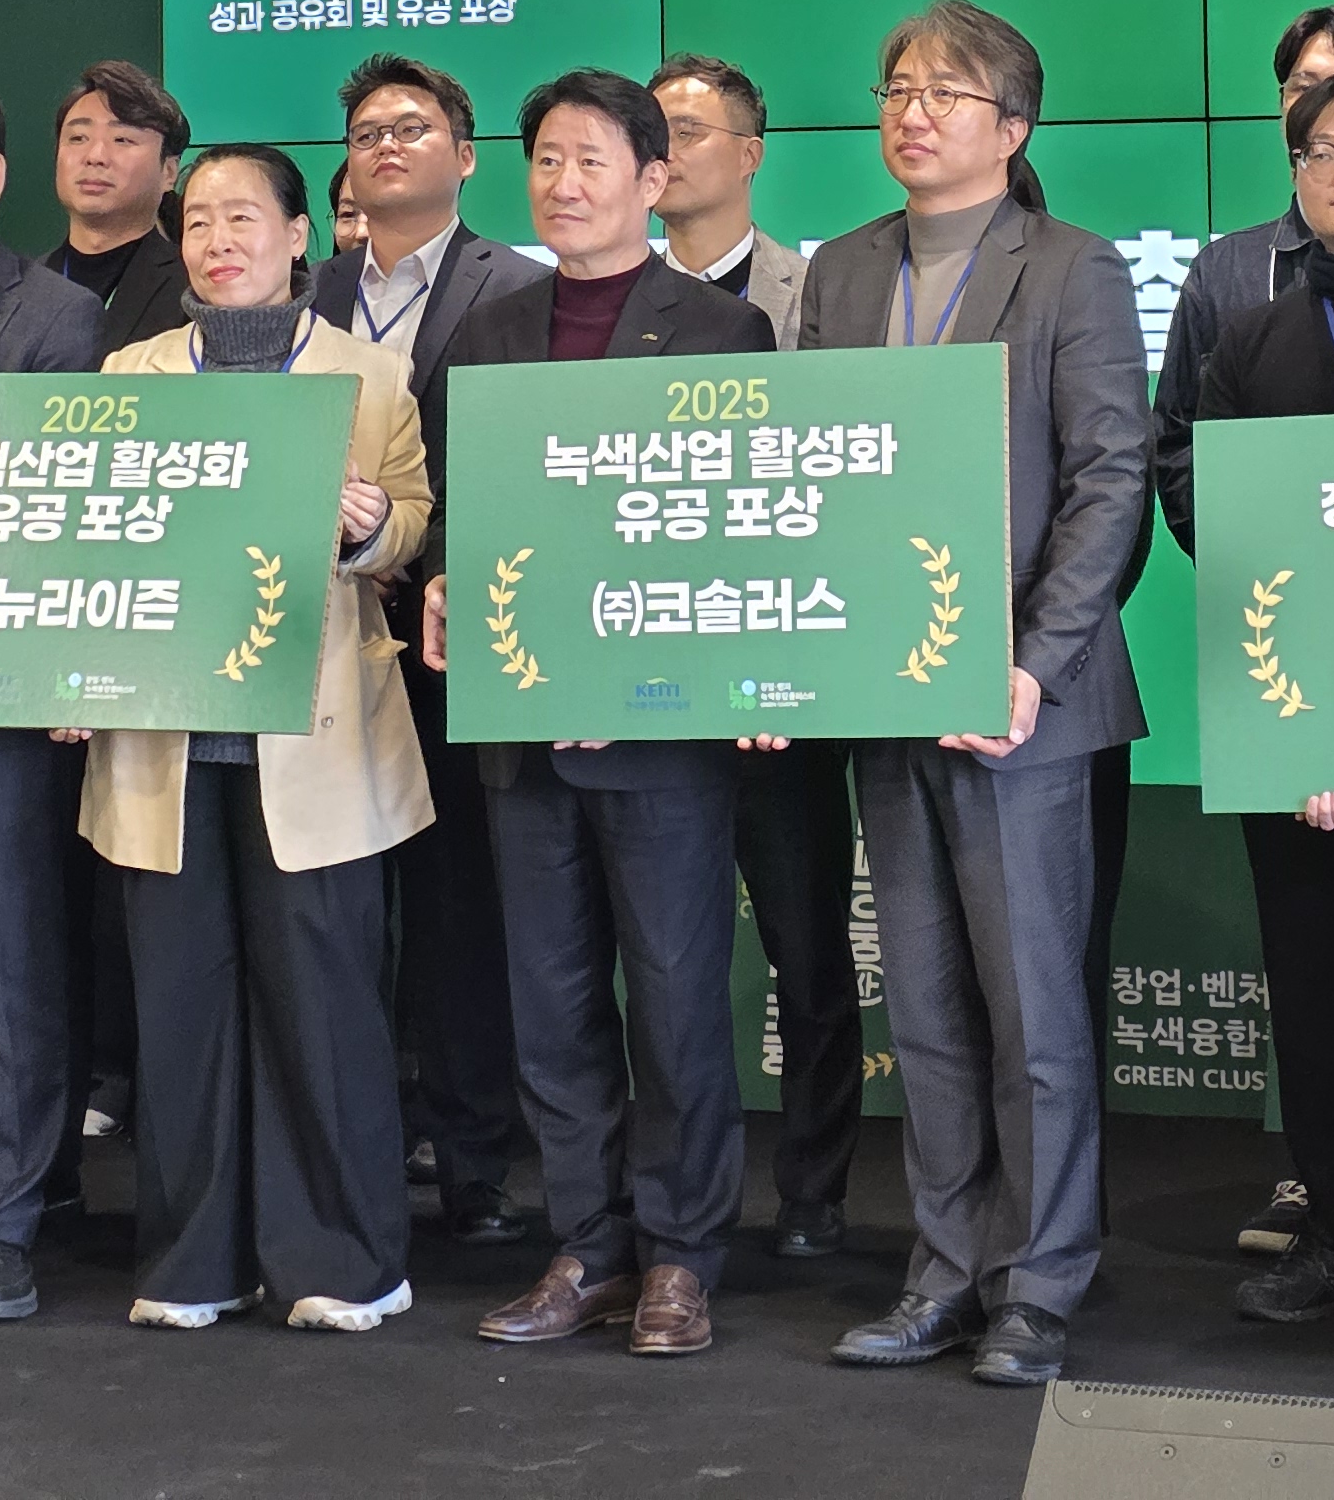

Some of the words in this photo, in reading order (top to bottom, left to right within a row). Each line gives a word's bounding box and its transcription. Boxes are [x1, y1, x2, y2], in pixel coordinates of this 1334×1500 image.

[208, 0, 266, 33] 성과
[40, 395, 140, 434] 2025
[666, 378, 770, 422] 2025
[109, 439, 250, 489] 활성화
[544, 429, 733, 486] 녹색산업
[748, 423, 898, 479] 활성화
[76, 494, 174, 543] 포상
[614, 488, 710, 543] 유공
[724, 484, 824, 538] 포상
[635, 684, 680, 698] KEITI
[1112, 1015, 1269, 1058] 녹색융합
[1113, 1064, 1195, 1088] GREEN
[1202, 1068, 1267, 1091] CLUS
